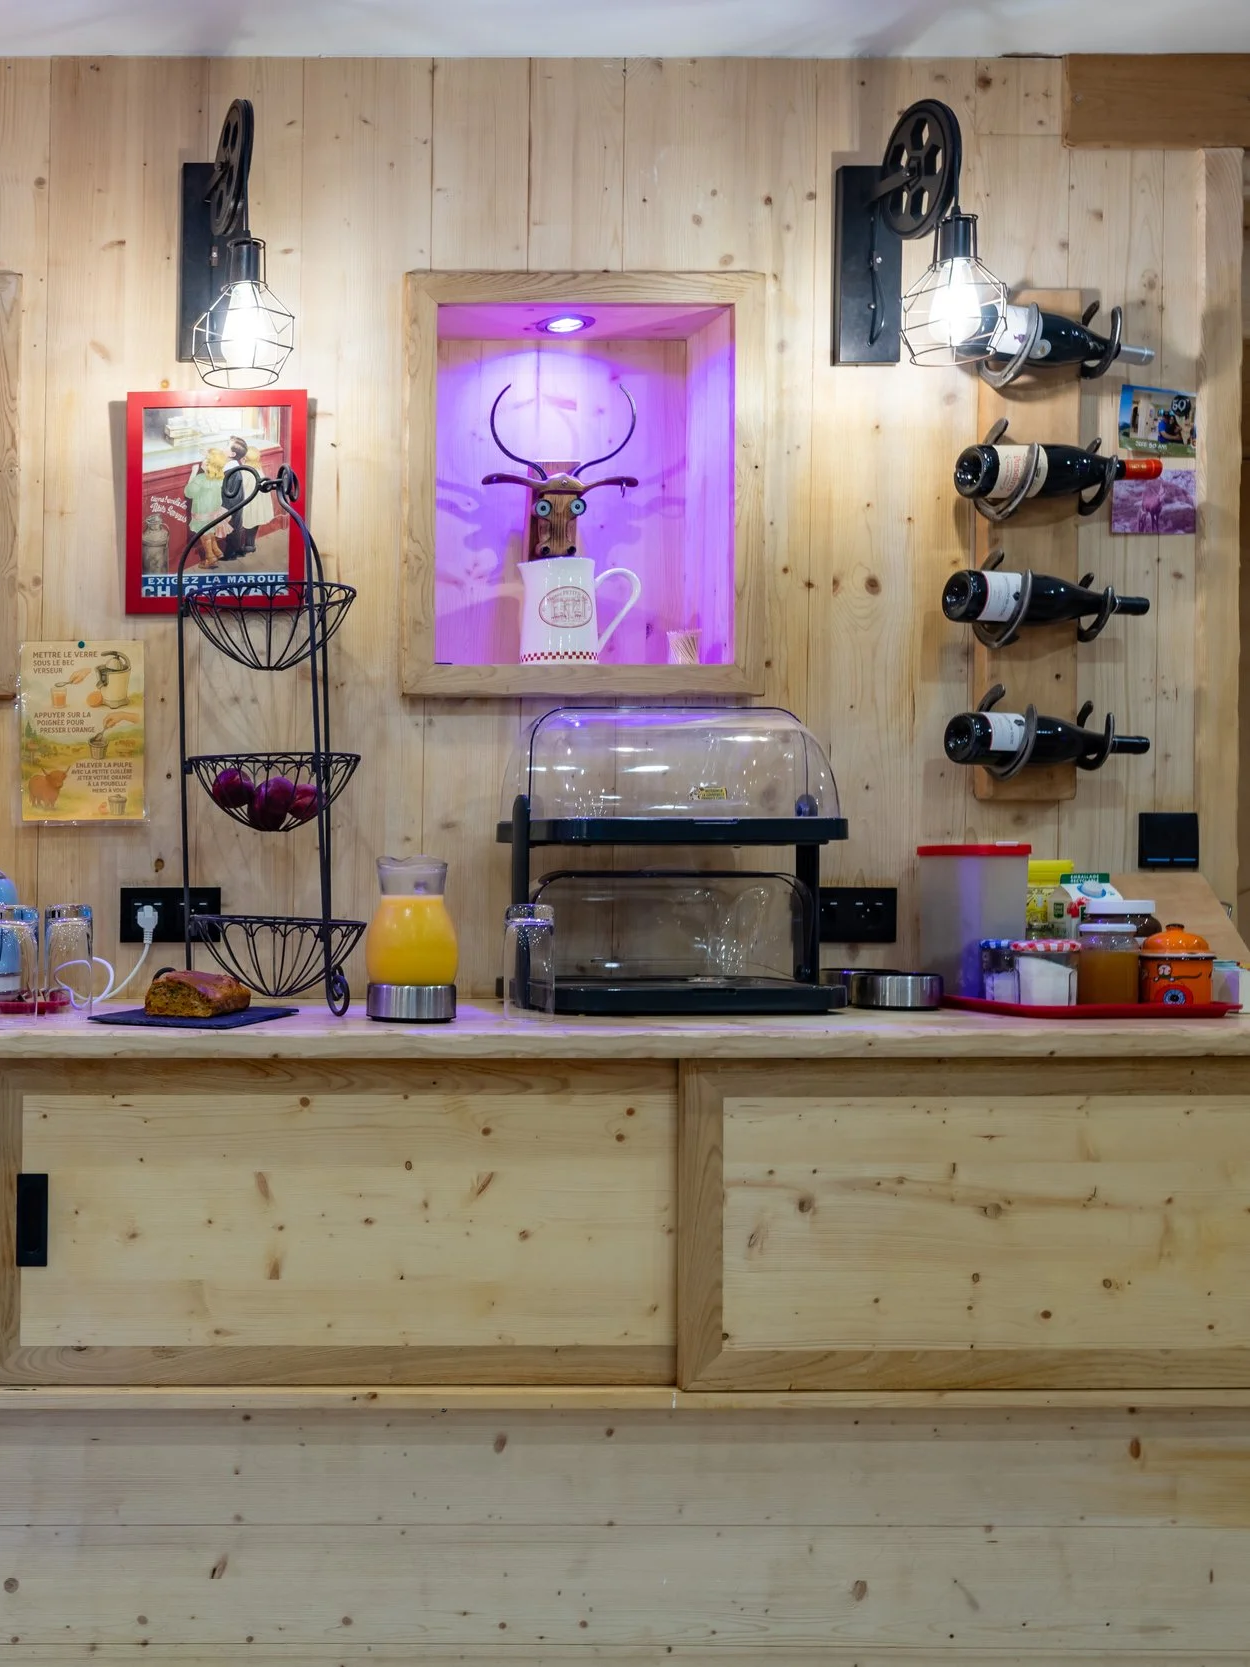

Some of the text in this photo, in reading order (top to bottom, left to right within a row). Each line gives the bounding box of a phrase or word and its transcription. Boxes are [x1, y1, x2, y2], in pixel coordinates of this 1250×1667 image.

[148, 576, 199, 585] EXIGEZ
[206, 576, 221, 584] LA
[33, 651, 62, 659] METTRE
